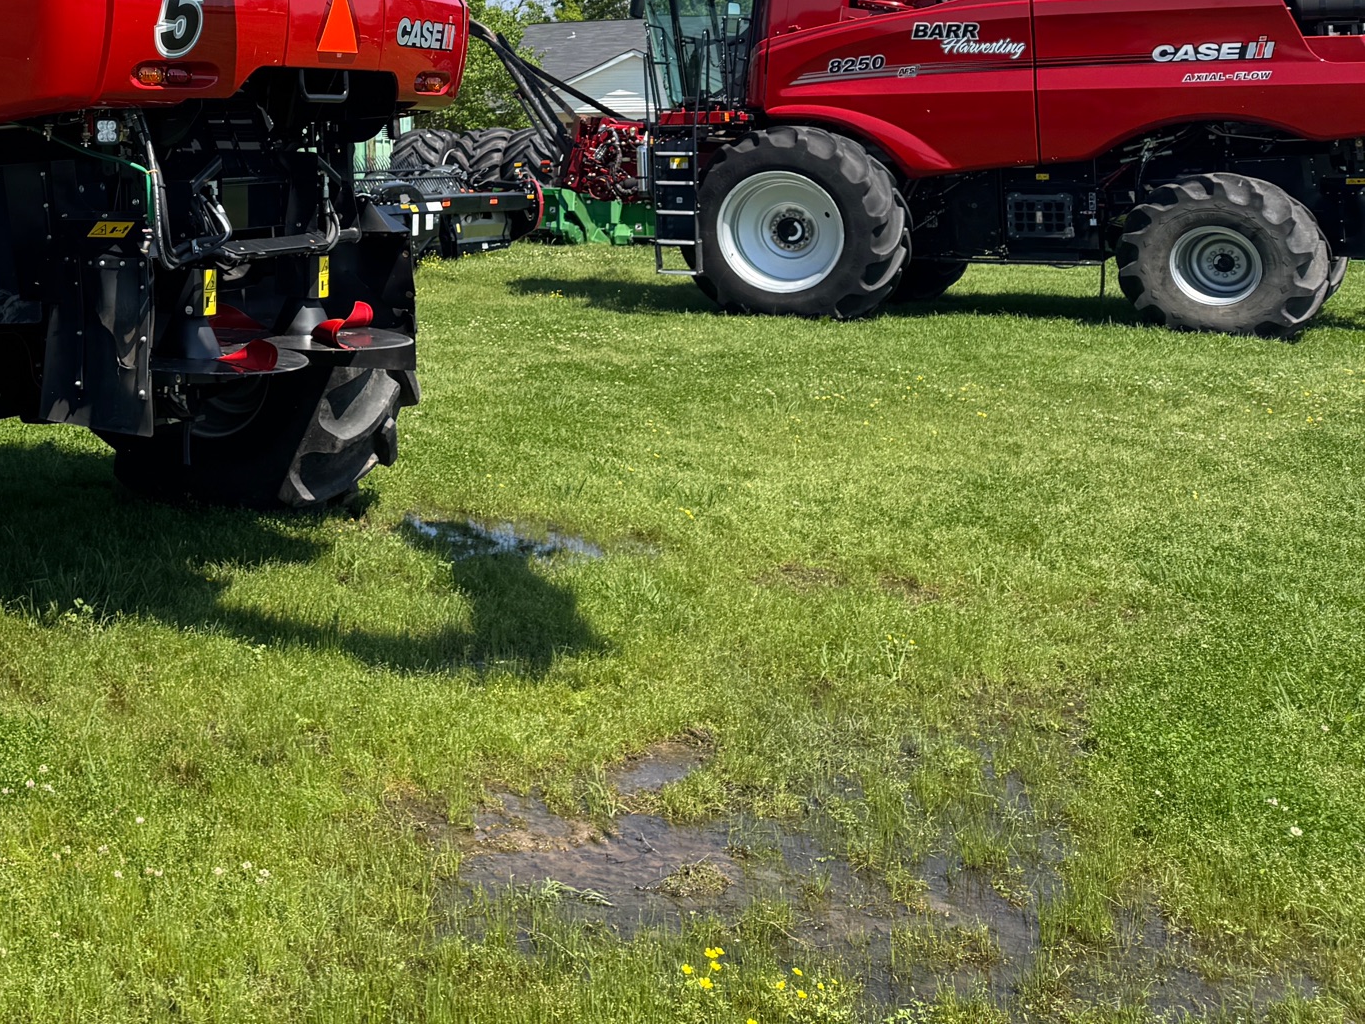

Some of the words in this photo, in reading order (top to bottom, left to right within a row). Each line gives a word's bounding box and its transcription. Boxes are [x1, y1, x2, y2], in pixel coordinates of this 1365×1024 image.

[396, 17, 443, 50] CASE
[911, 22, 980, 40] BARR
[941, 37, 1026, 59] Harvesting
[1151, 42, 1243, 62] CASE
[828, 55, 885, 74] 8250
[897, 66, 917, 77] AFS
